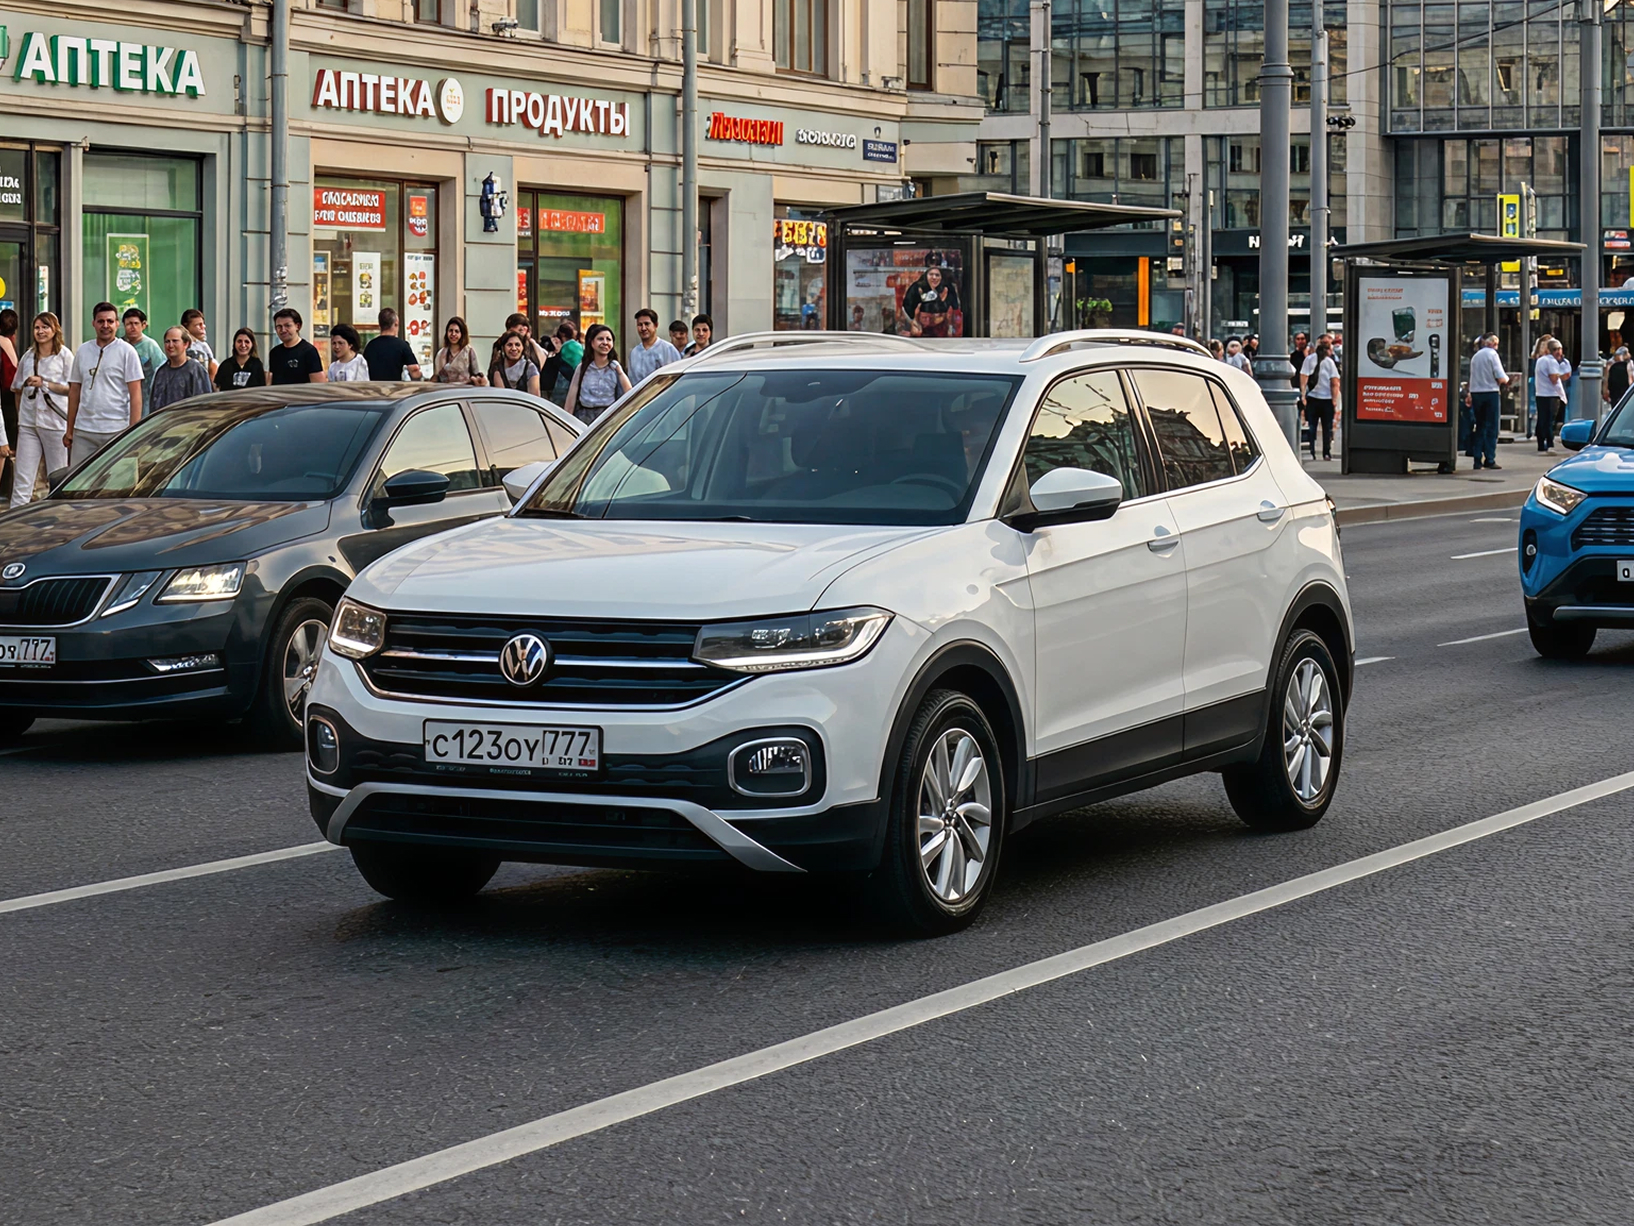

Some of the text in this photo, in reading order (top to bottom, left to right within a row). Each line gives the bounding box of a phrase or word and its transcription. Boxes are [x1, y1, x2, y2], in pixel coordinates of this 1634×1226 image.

[18, 31, 206, 97] АПТЕКА
[315, 69, 437, 117] АПТЕКА
[489, 88, 630, 138] ПРОДУКТЫ
